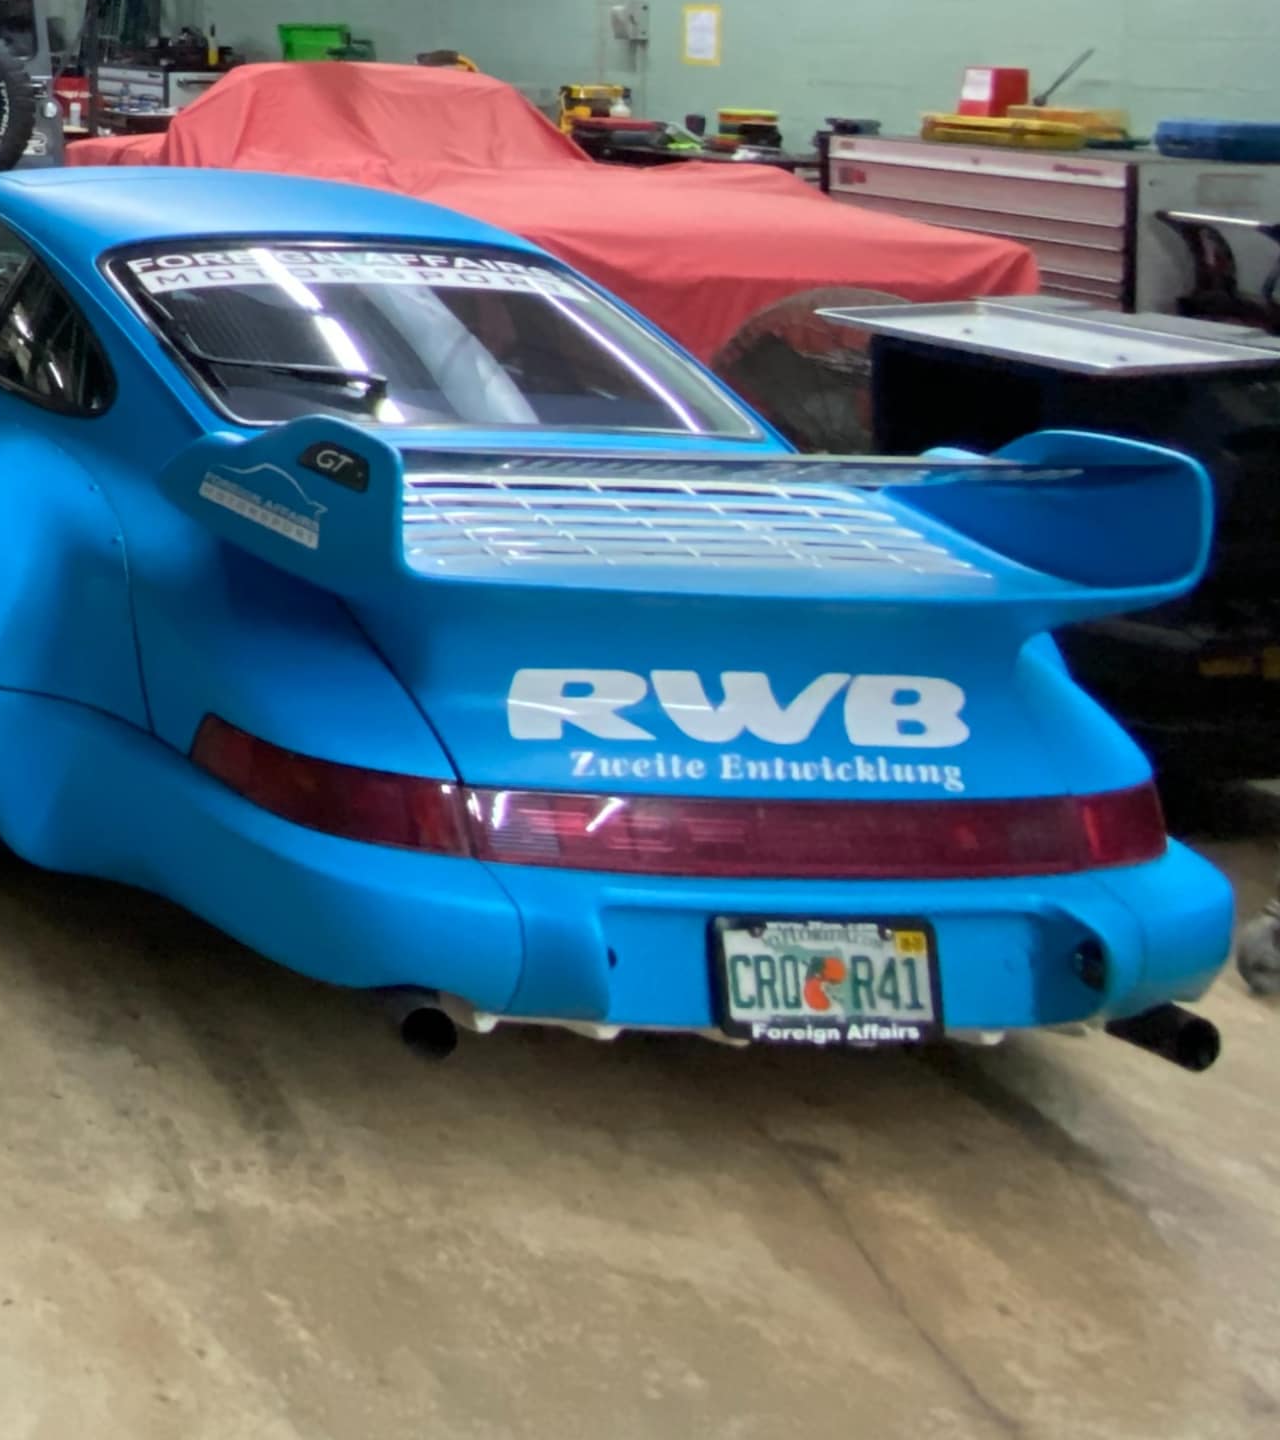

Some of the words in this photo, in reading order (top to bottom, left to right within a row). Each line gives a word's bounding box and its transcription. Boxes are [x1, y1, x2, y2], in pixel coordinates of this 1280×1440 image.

[127, 249, 344, 273] FOREGN
[316, 449, 354, 473] GT
[507, 668, 971, 748] RWB
[569, 751, 707, 780] Zweite
[719, 753, 966, 793] Entwicklung
[850, 955, 925, 1010] R41
[752, 1024, 840, 1044] Foreign
[847, 1024, 921, 1041] Affairs
